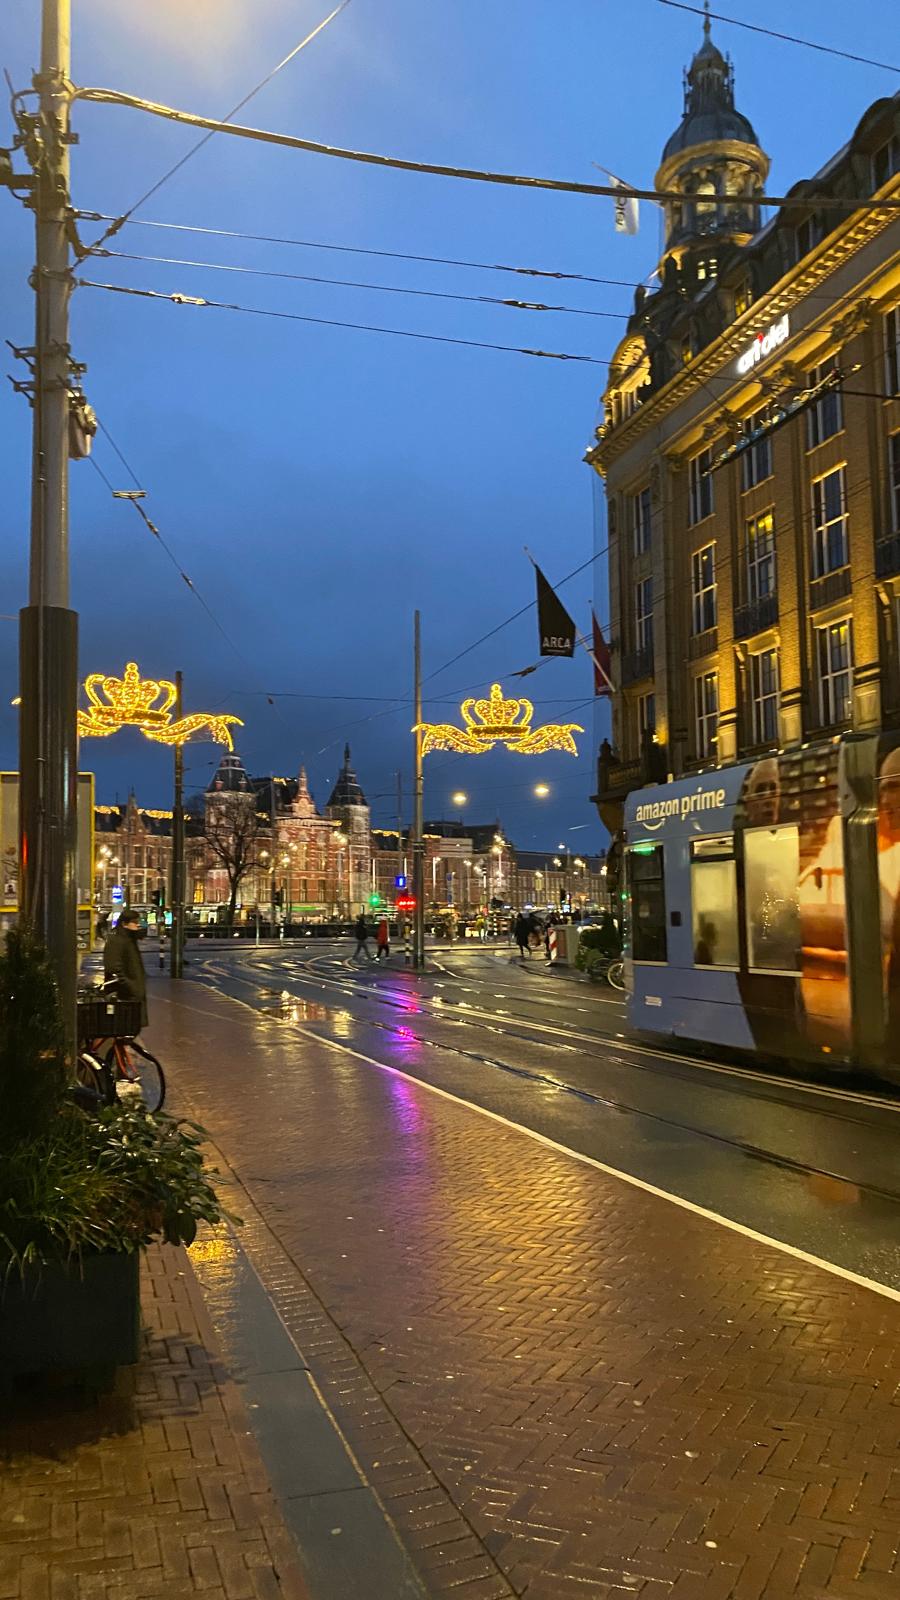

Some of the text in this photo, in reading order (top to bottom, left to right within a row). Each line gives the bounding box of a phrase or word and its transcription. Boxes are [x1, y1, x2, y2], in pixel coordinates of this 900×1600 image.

[542, 637, 570, 648] ARCA
[636, 787, 725, 821] amazon prime
